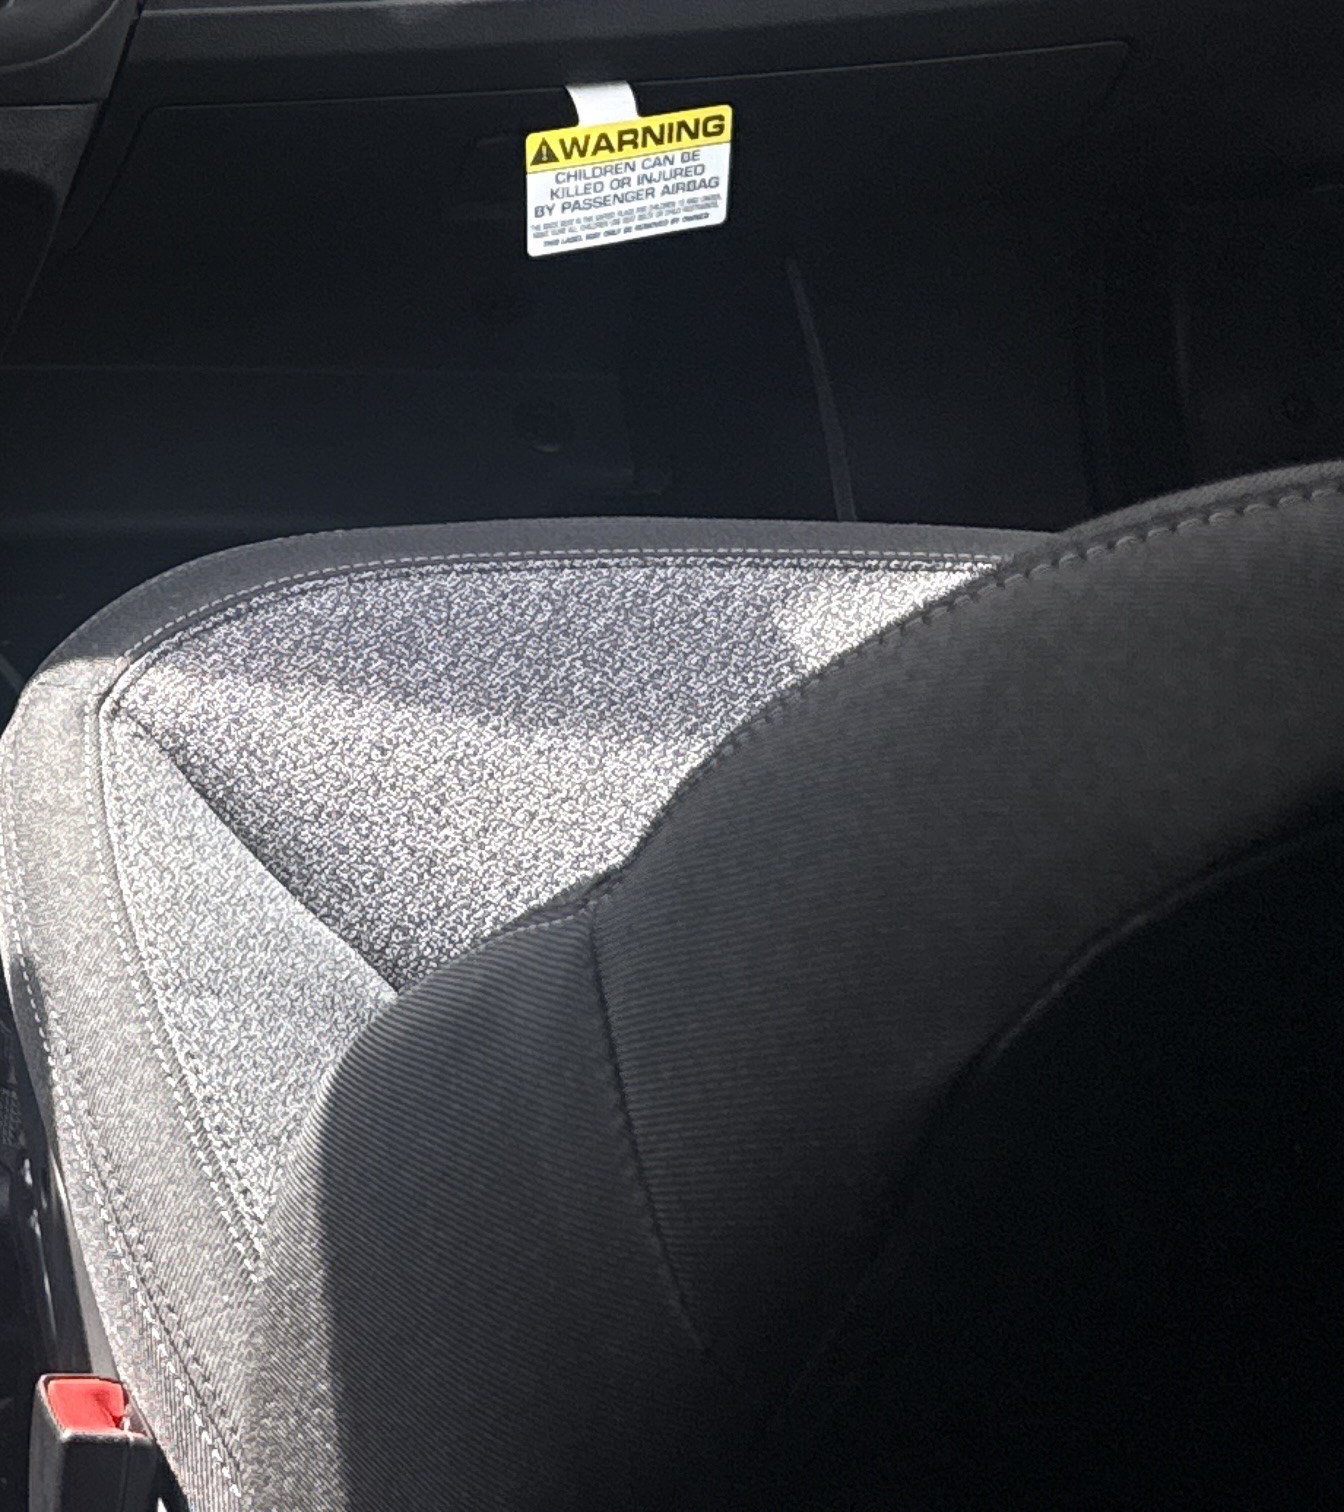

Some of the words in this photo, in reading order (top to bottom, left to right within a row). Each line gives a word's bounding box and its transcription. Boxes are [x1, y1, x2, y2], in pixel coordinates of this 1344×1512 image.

[558, 114, 726, 160] WARNING
[549, 181, 604, 201] KILLED
[609, 176, 632, 191] OR
[636, 164, 706, 187] INJURED
[554, 161, 637, 185] CHILDREN
[641, 152, 675, 170] CAN
[680, 149, 701, 164] BE
[534, 203, 556, 219] BY
[561, 188, 656, 213] PASSENGER
[661, 176, 721, 197] AIRBAG
